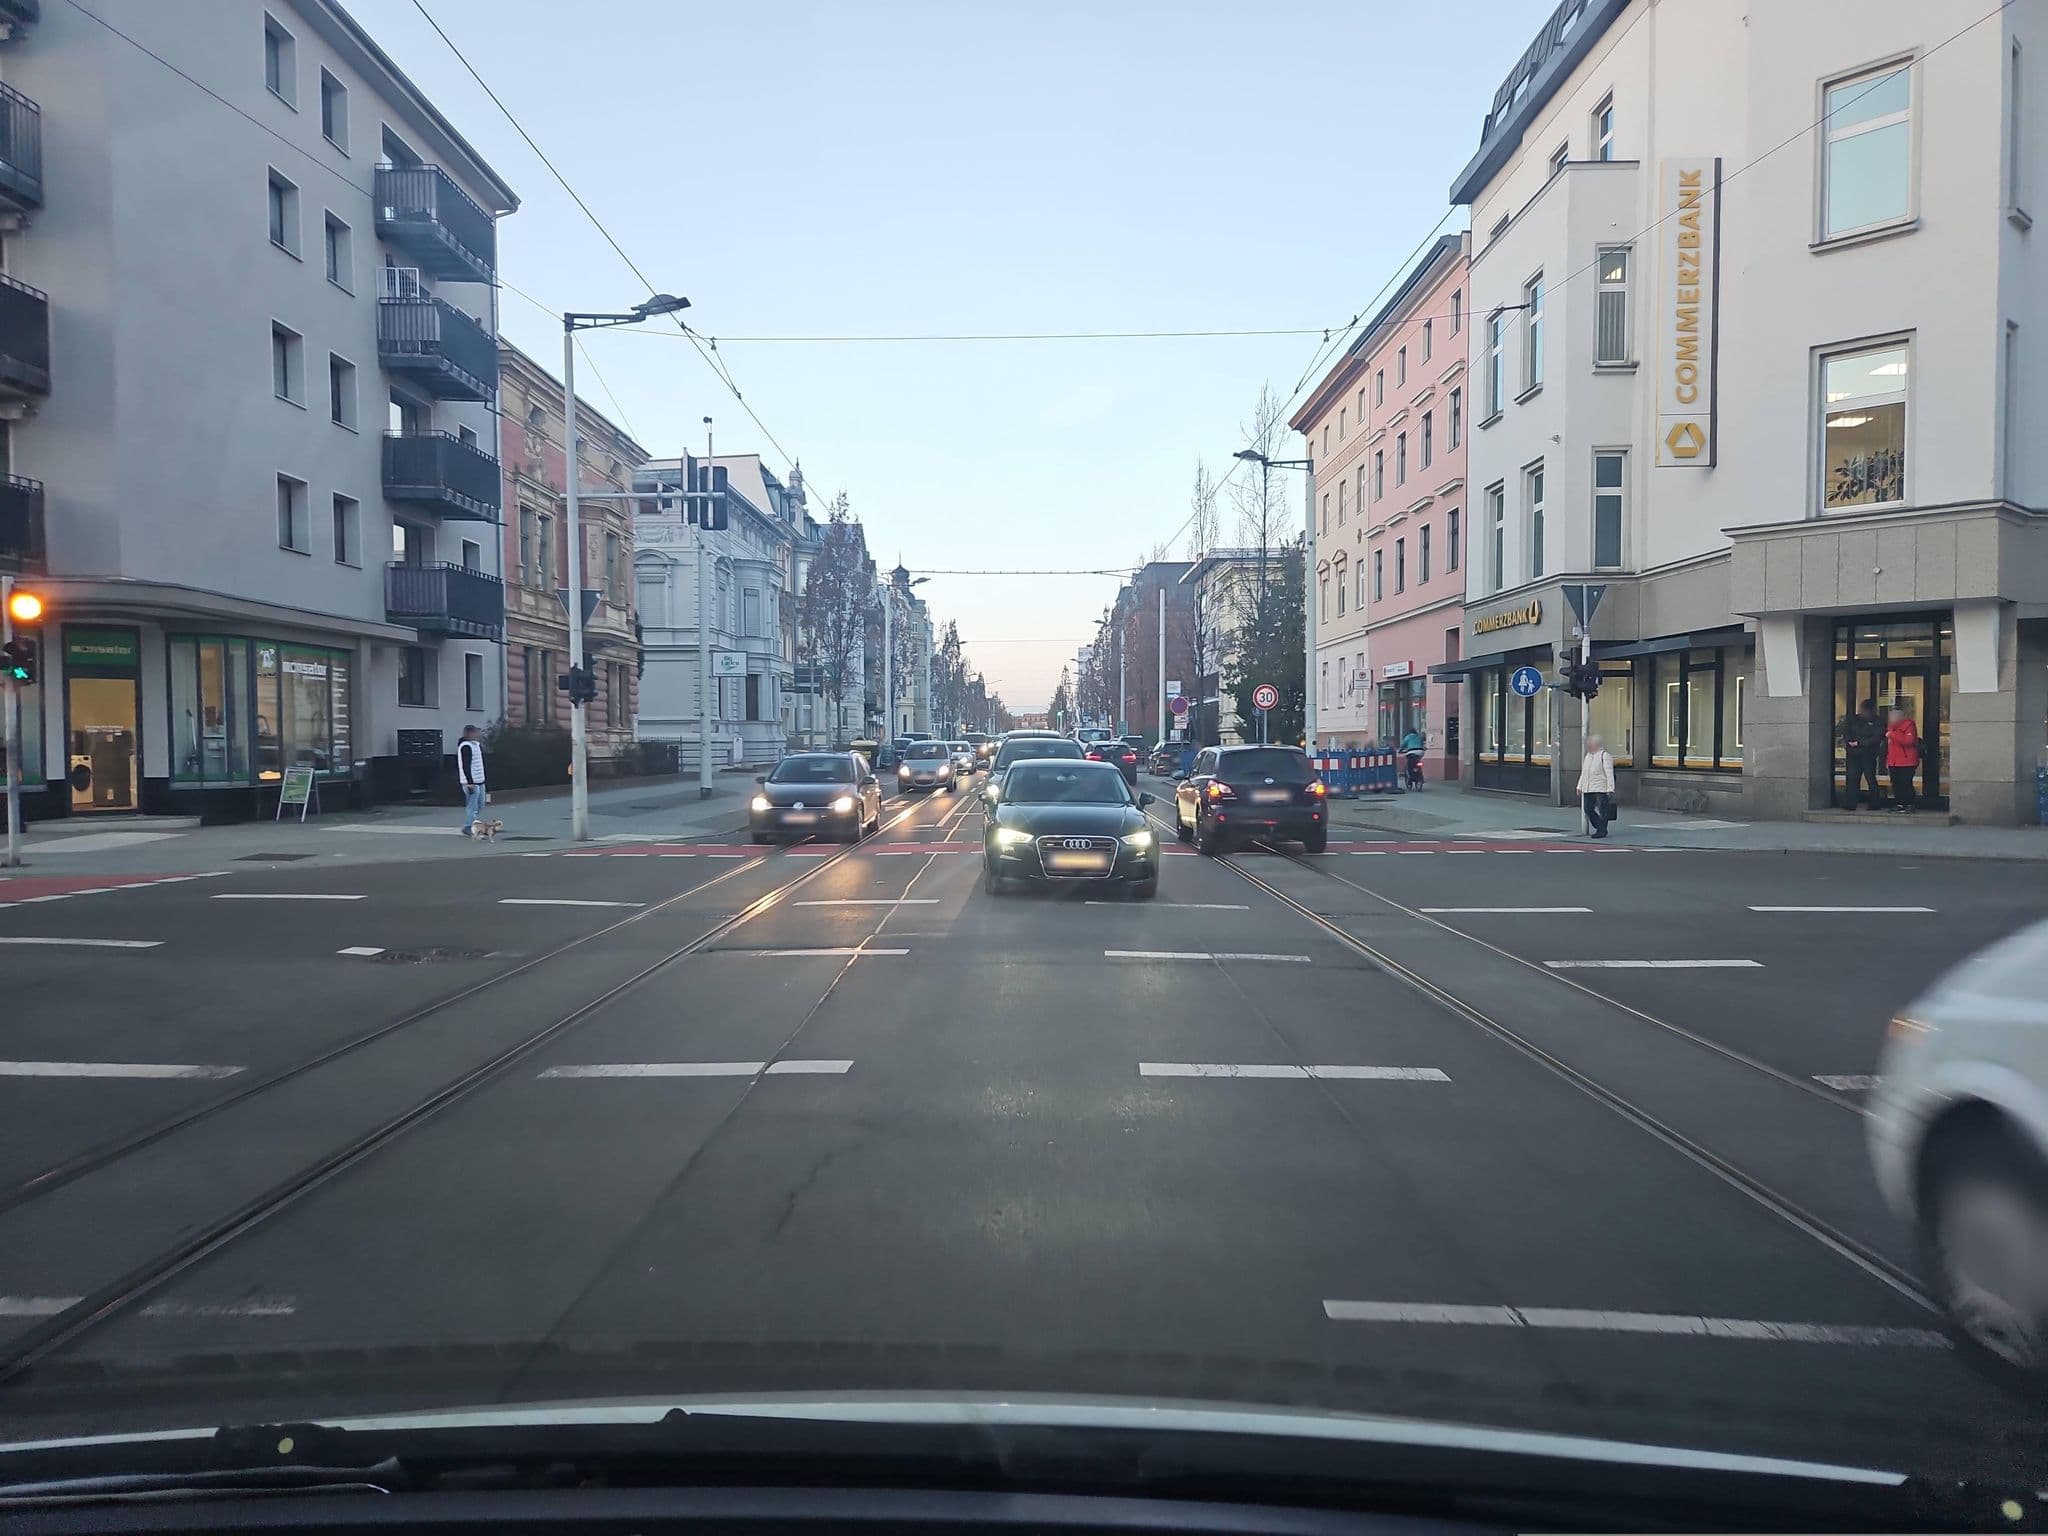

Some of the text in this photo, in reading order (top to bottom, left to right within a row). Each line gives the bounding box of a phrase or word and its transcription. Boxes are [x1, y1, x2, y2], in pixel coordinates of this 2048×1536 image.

[1675, 168, 1702, 404] COMMERZBANK
[1473, 607, 1528, 635] COMMERZBANK
[1259, 691, 1273, 703] 30
